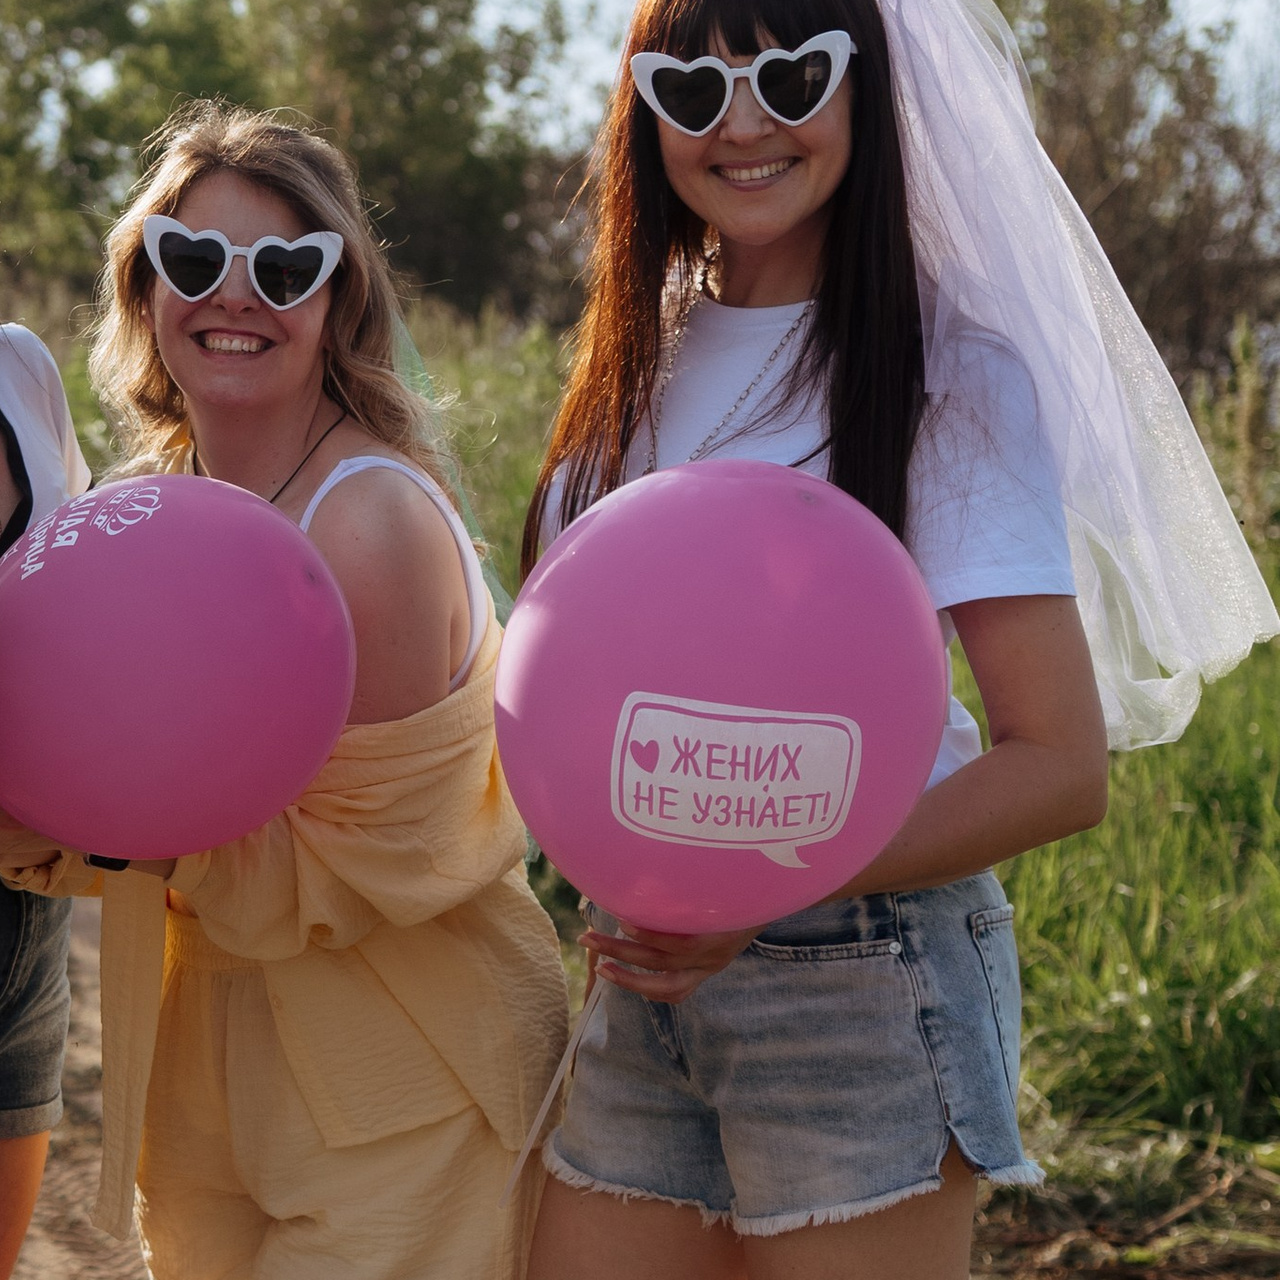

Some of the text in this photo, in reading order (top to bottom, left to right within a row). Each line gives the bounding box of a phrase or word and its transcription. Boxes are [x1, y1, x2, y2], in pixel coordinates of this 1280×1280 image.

[670, 734, 803, 783] ЖЕНИХ
[633, 781, 832, 828] НЕ УЗНАЕТ!
